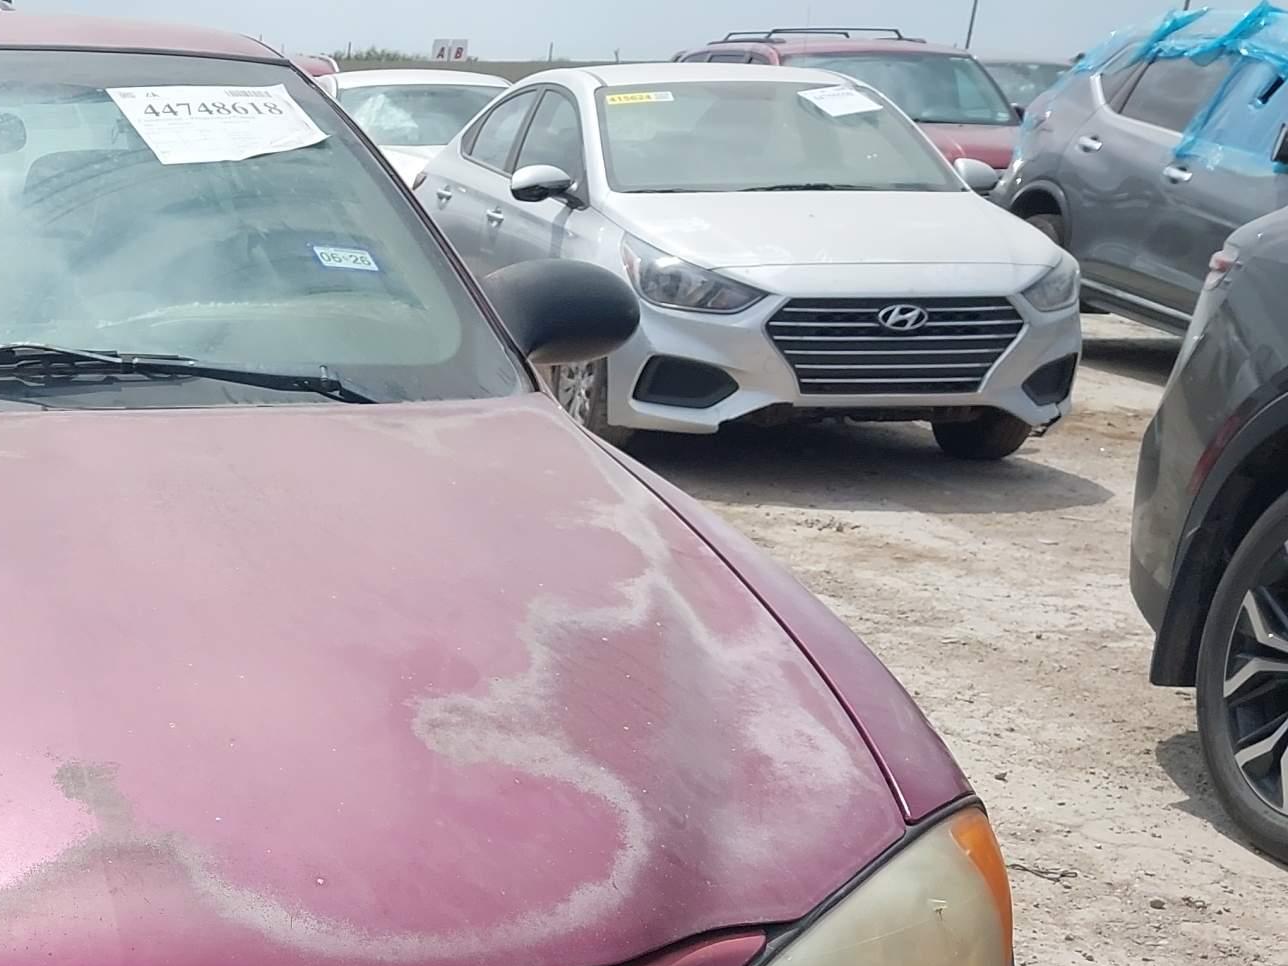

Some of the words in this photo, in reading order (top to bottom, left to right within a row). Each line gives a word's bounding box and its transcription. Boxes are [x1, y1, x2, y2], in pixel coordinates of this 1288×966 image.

[436, 46, 445, 59] A
[454, 46, 464, 59] B
[143, 102, 284, 117] 44748618
